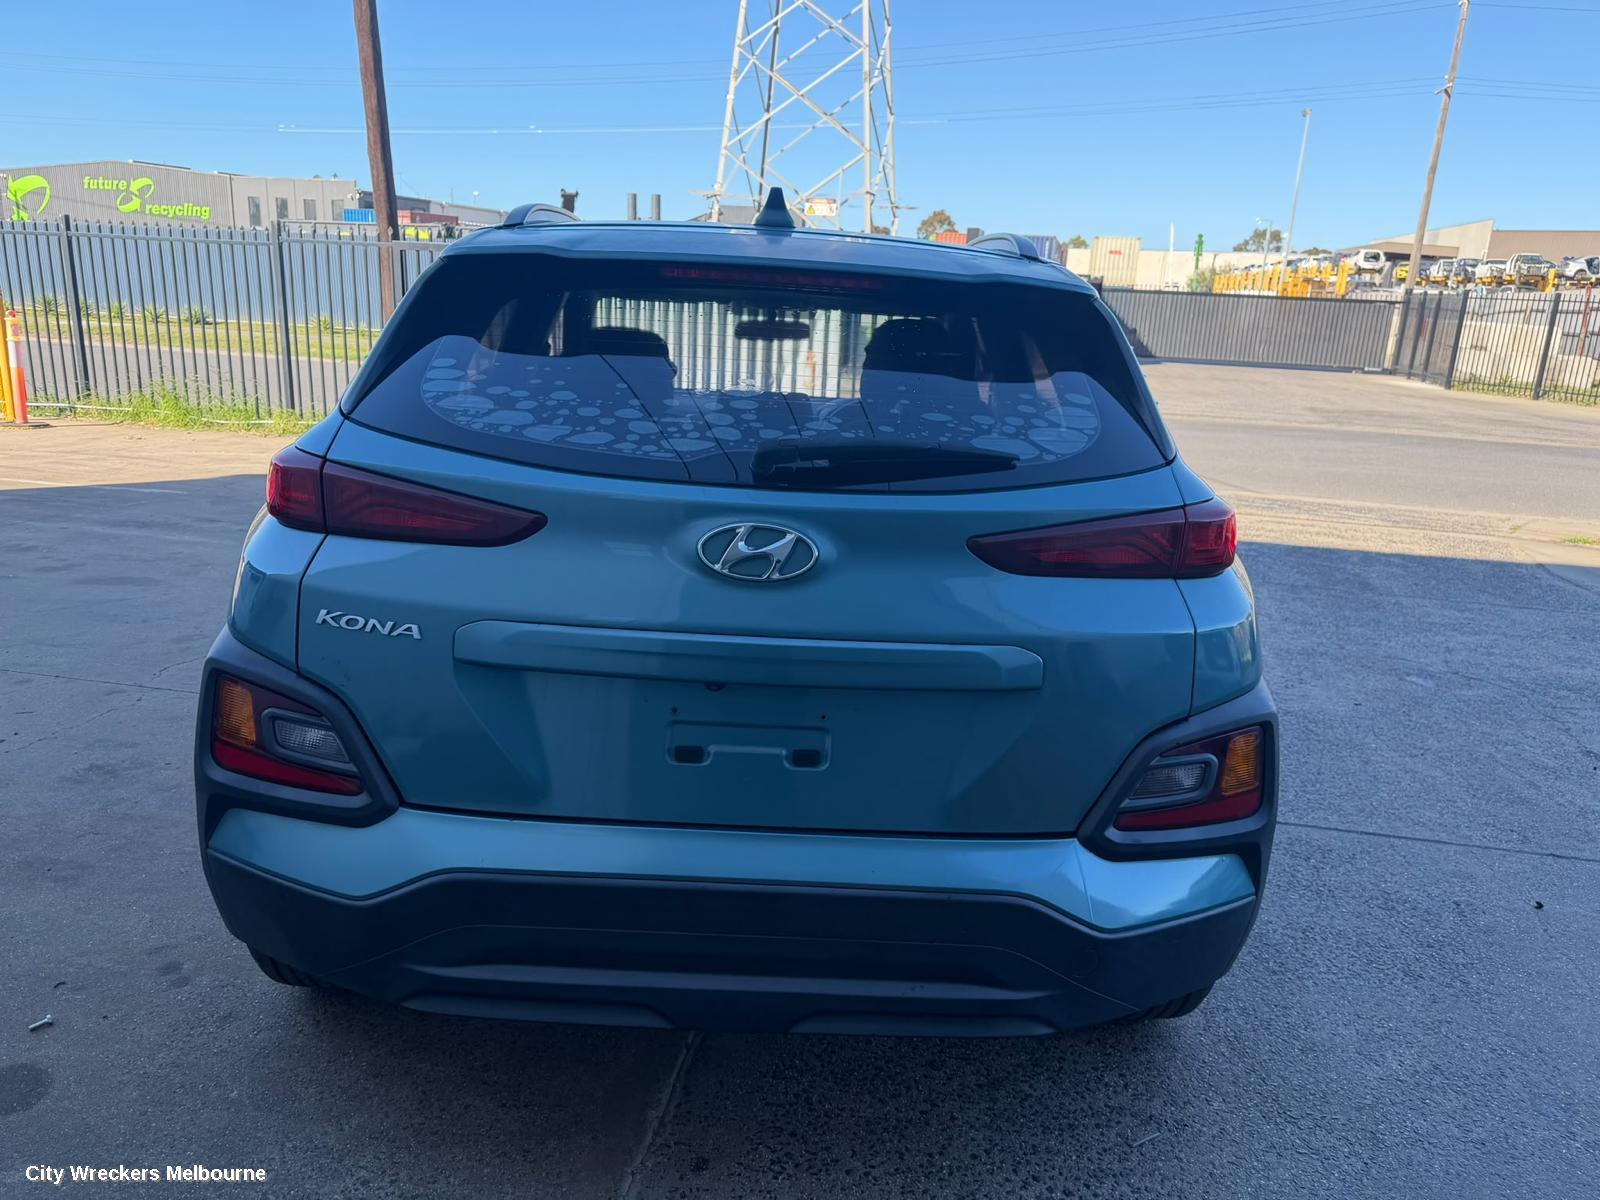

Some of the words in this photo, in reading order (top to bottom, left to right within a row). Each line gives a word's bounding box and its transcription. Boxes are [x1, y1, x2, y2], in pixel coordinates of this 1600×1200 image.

[83, 176, 128, 190] future
[145, 202, 210, 219] recycling
[315, 608, 422, 640] KONA
